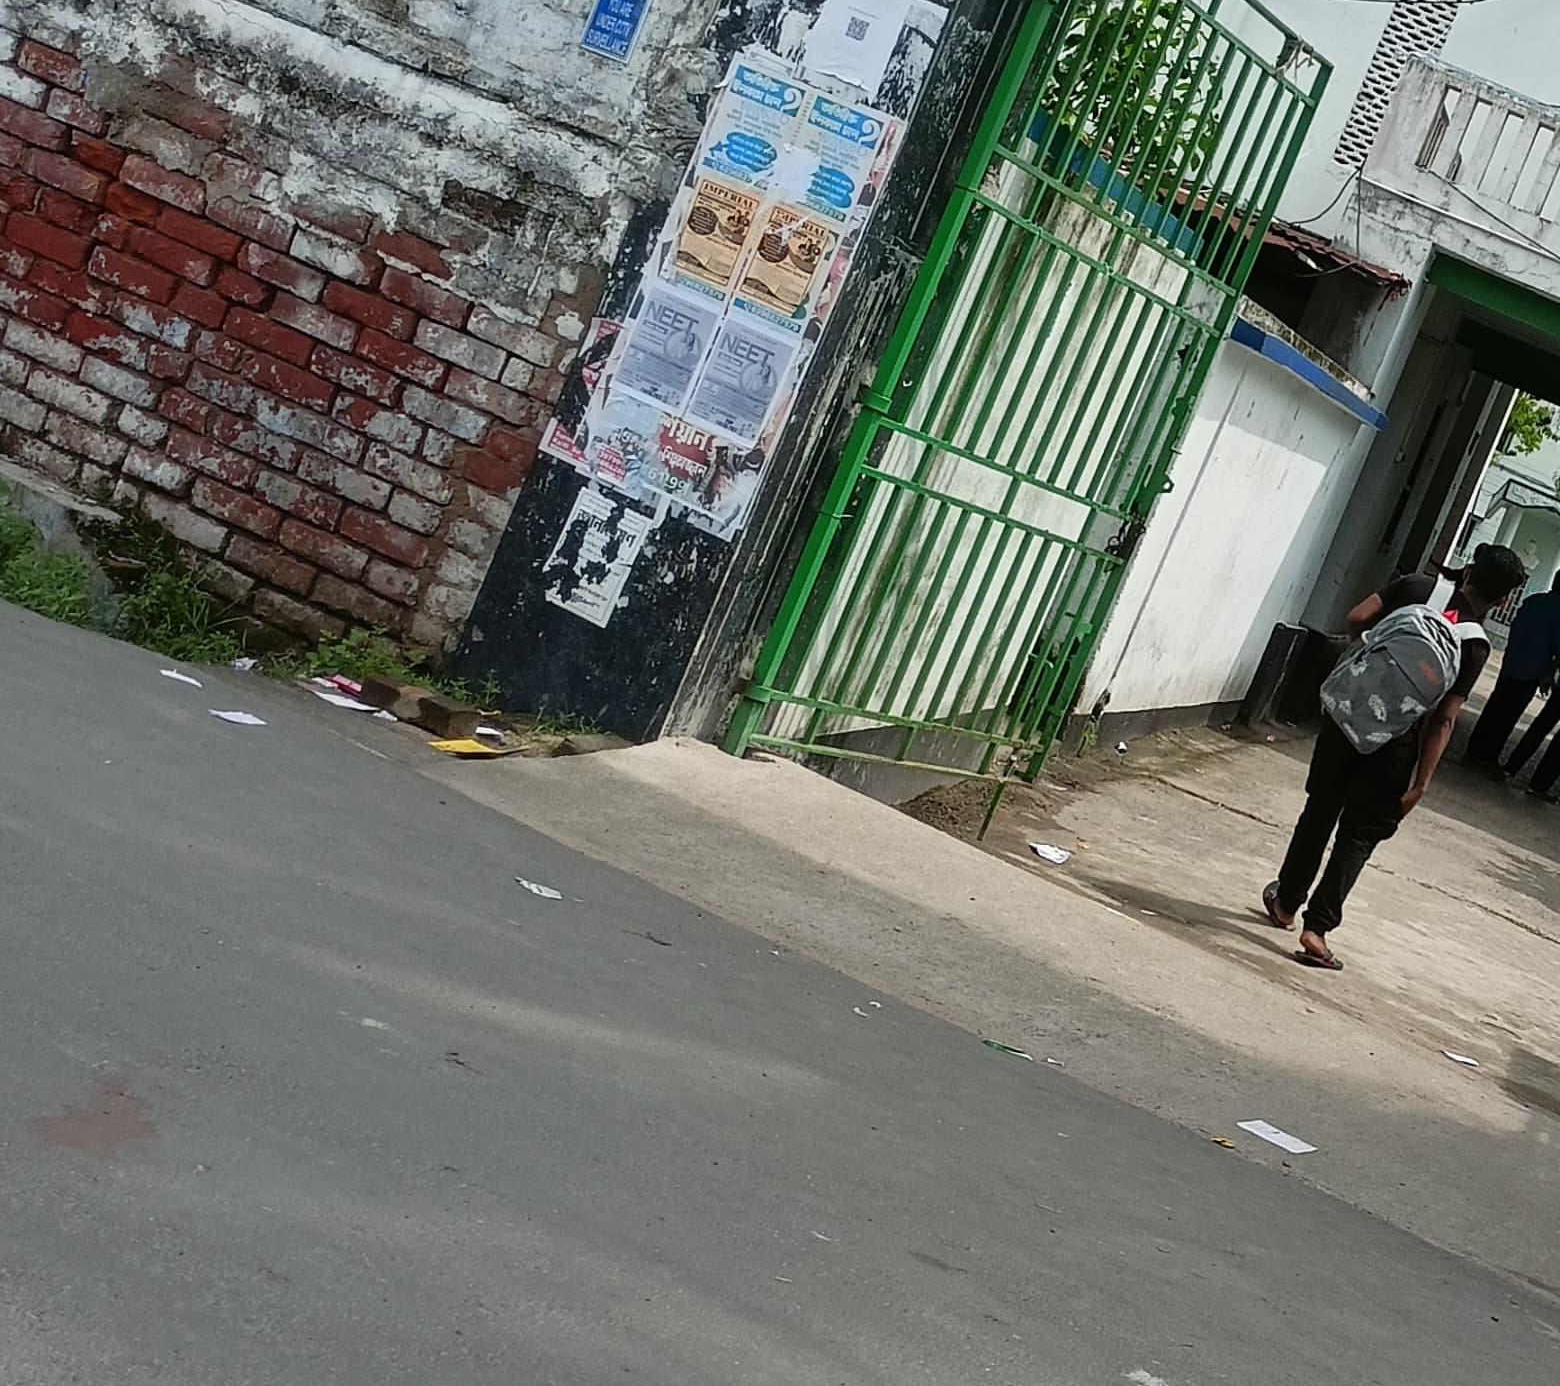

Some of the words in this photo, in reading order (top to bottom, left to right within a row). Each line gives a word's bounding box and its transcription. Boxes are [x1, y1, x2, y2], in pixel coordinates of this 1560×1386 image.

[595, 13, 617, 32] UNDER
[619, 2, 635, 18] ARE
[586, 28, 629, 56] SURVEILLANCE
[704, 183, 757, 209] IMPERIAL
[644, 301, 700, 337] NEET
[719, 332, 776, 369] NEET
